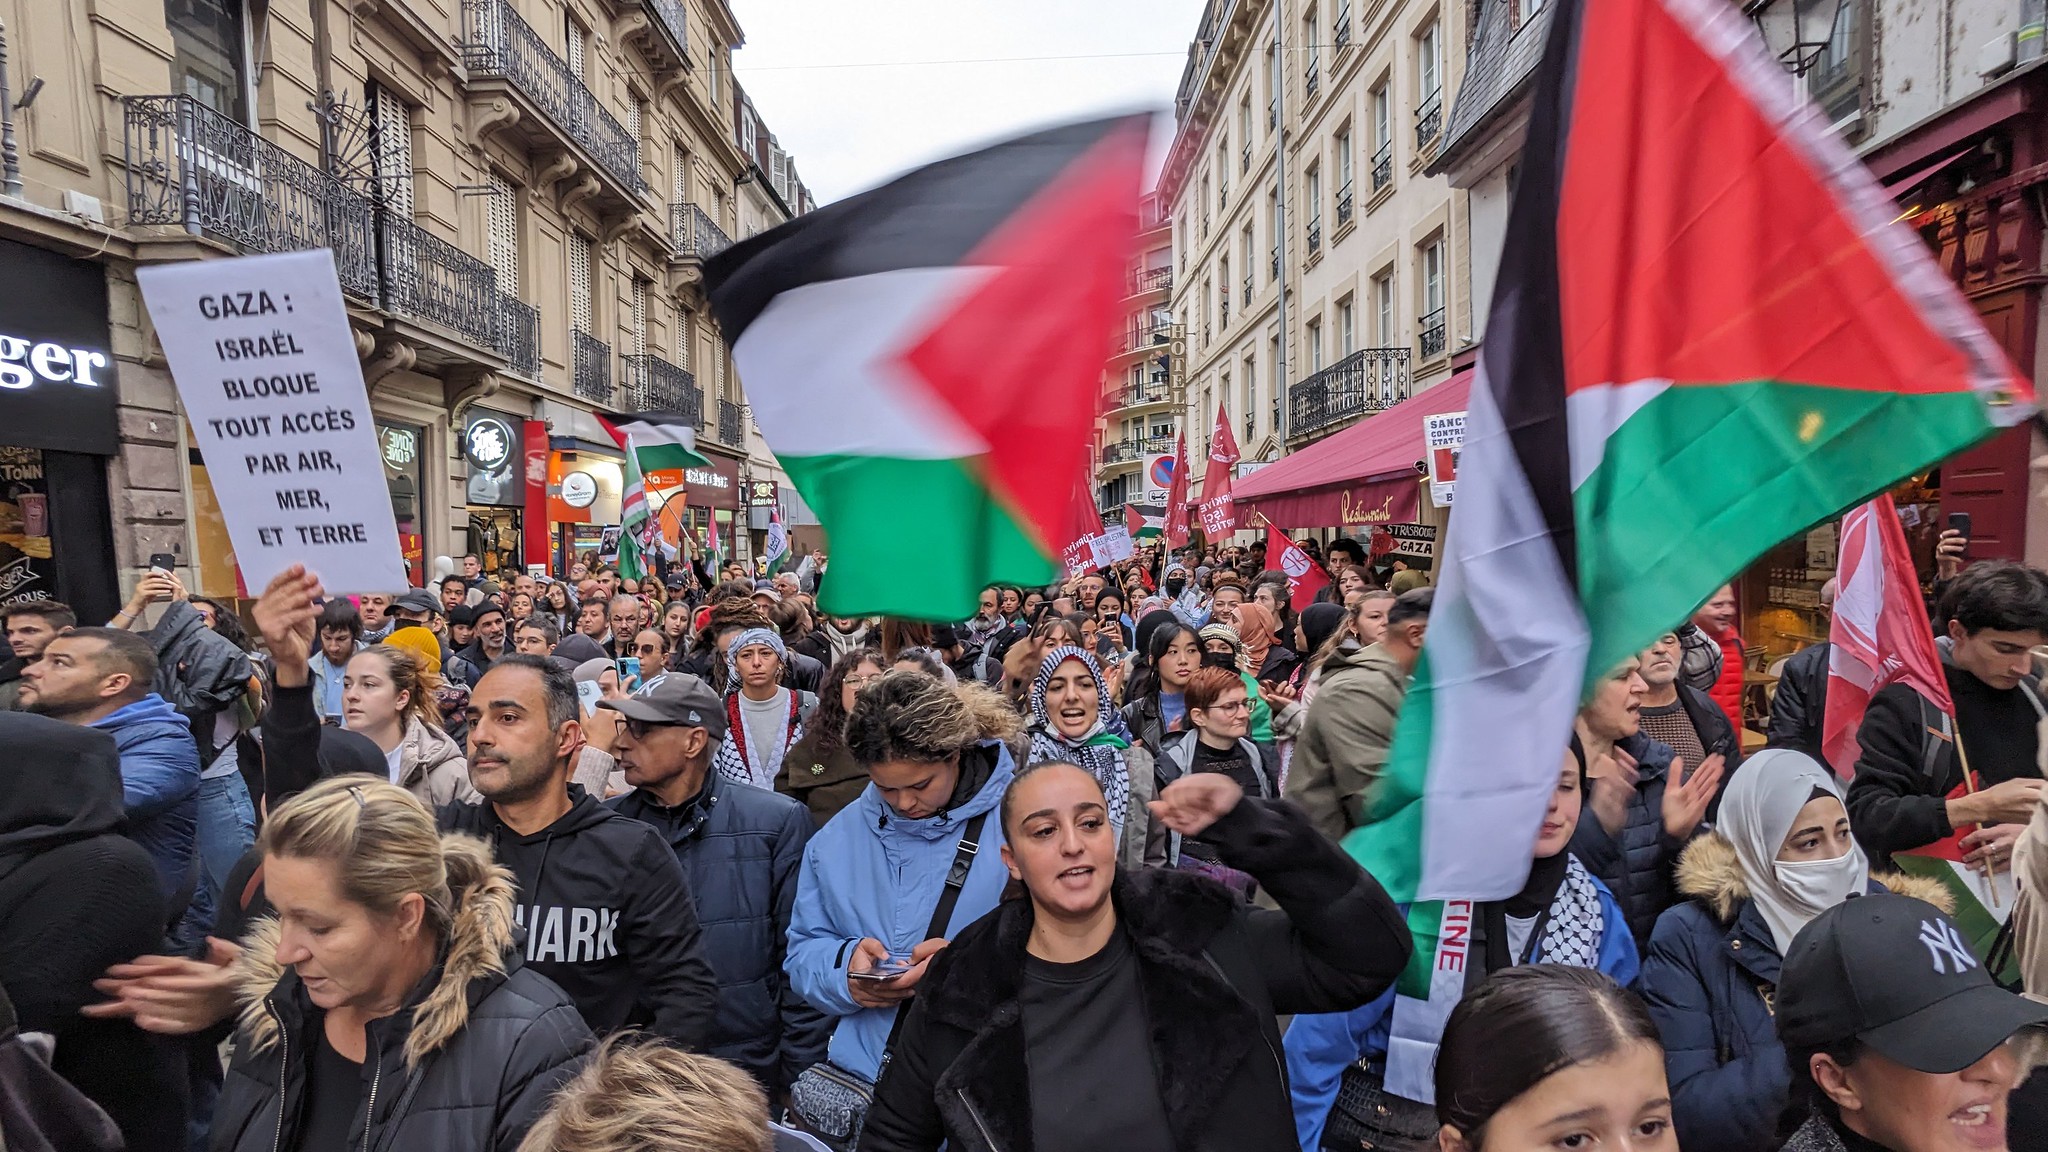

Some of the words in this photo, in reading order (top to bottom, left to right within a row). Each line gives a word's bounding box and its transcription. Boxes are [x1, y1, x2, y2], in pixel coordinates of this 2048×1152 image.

[199, 289, 278, 320] GAZA
[215, 329, 304, 362] ISRAËL
[1170, 324, 1186, 405] HOTEL
[222, 373, 321, 401] BLOQUE
[208, 415, 272, 440] TOUT
[282, 405, 356, 436] ACCÈS
[1431, 428, 1465, 438] CONTRE
[1432, 438, 1454, 446] ETAT
[245, 453, 291, 475] PAR
[299, 450, 342, 474] AIR,
[275, 488, 330, 512] MER,
[1342, 489, 1393, 523] Restaurant
[257, 527, 283, 546] ET
[295, 523, 367, 545] TERRE
[1400, 541, 1433, 554] GAZA
[1919, 917, 1977, 974] NY
